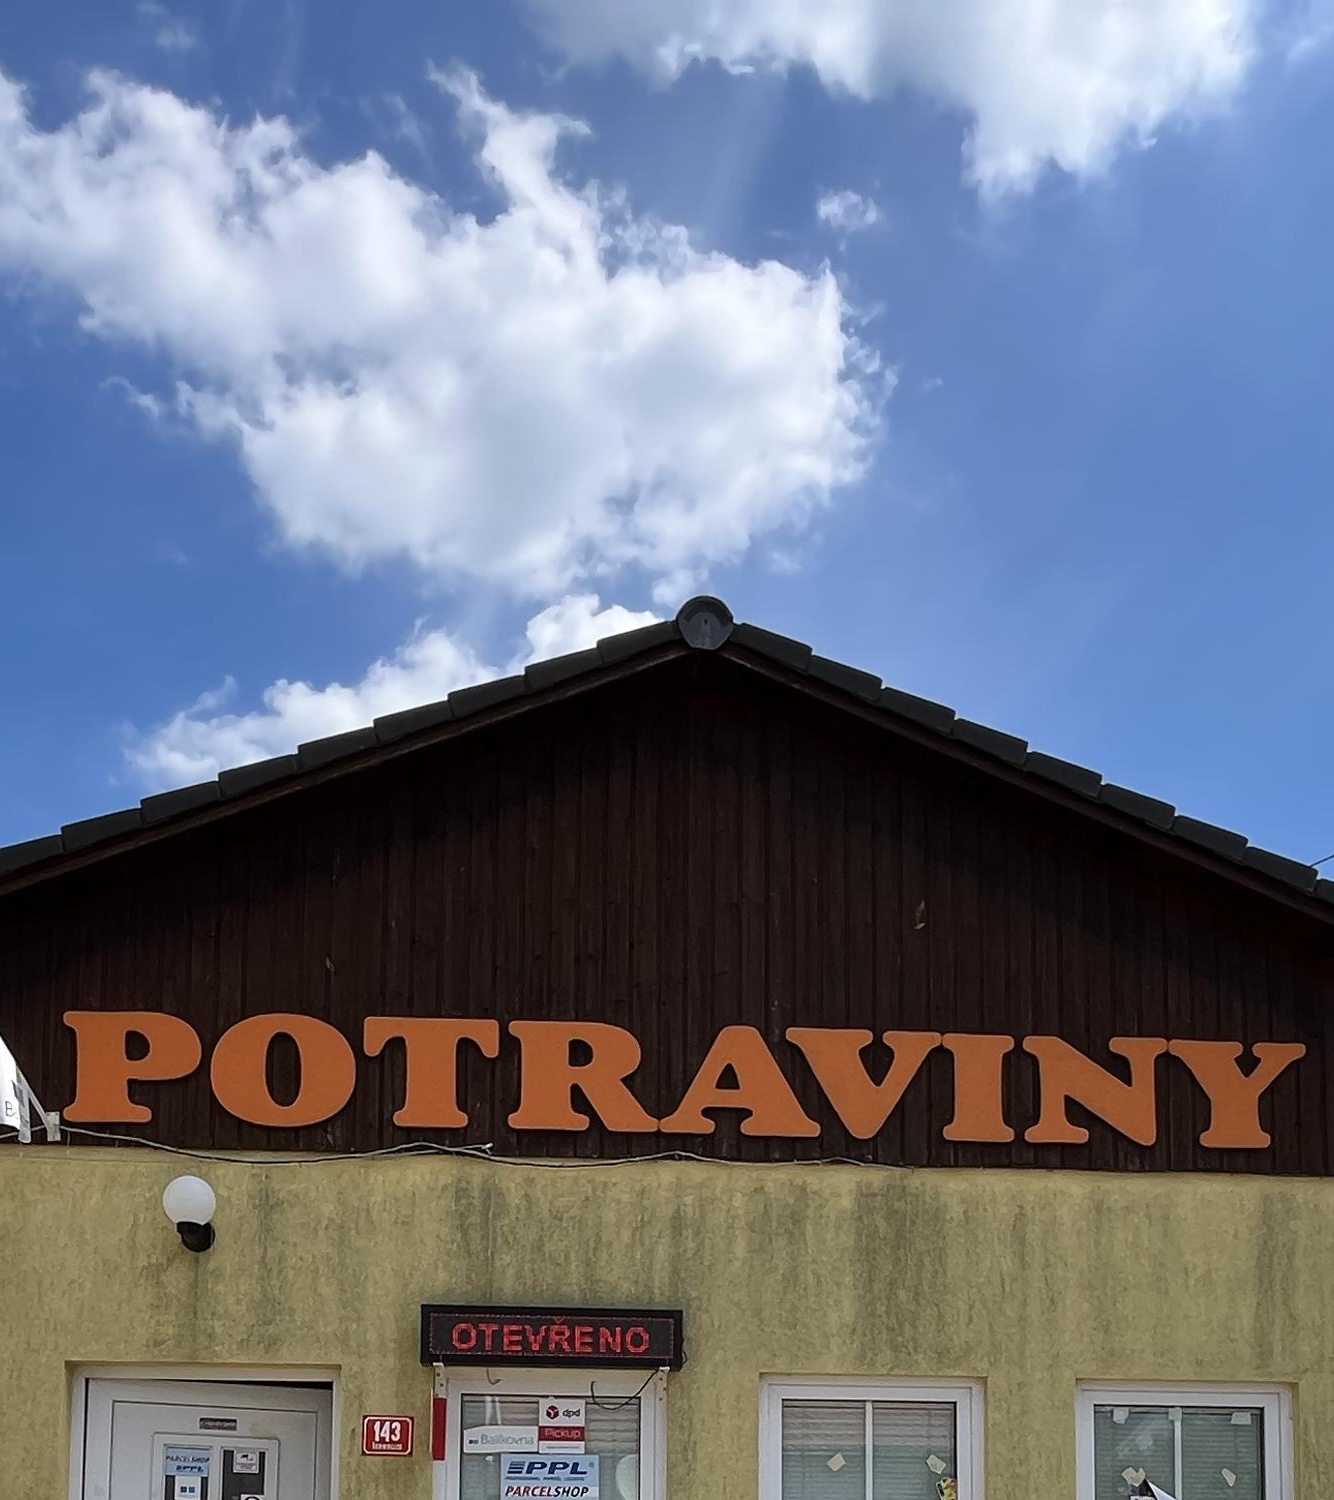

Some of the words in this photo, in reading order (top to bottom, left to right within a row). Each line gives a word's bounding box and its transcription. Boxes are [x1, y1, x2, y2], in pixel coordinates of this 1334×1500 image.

[62, 1010, 1307, 1149] POTRAVINY
[451, 1315, 650, 1355] OTEVŘENO
[562, 1407, 581, 1418] dpd
[374, 1420, 401, 1442] 143
[544, 1429, 581, 1440] Pickup
[526, 1461, 588, 1475] PPL
[505, 1486, 589, 1498] PARCELSHOP
